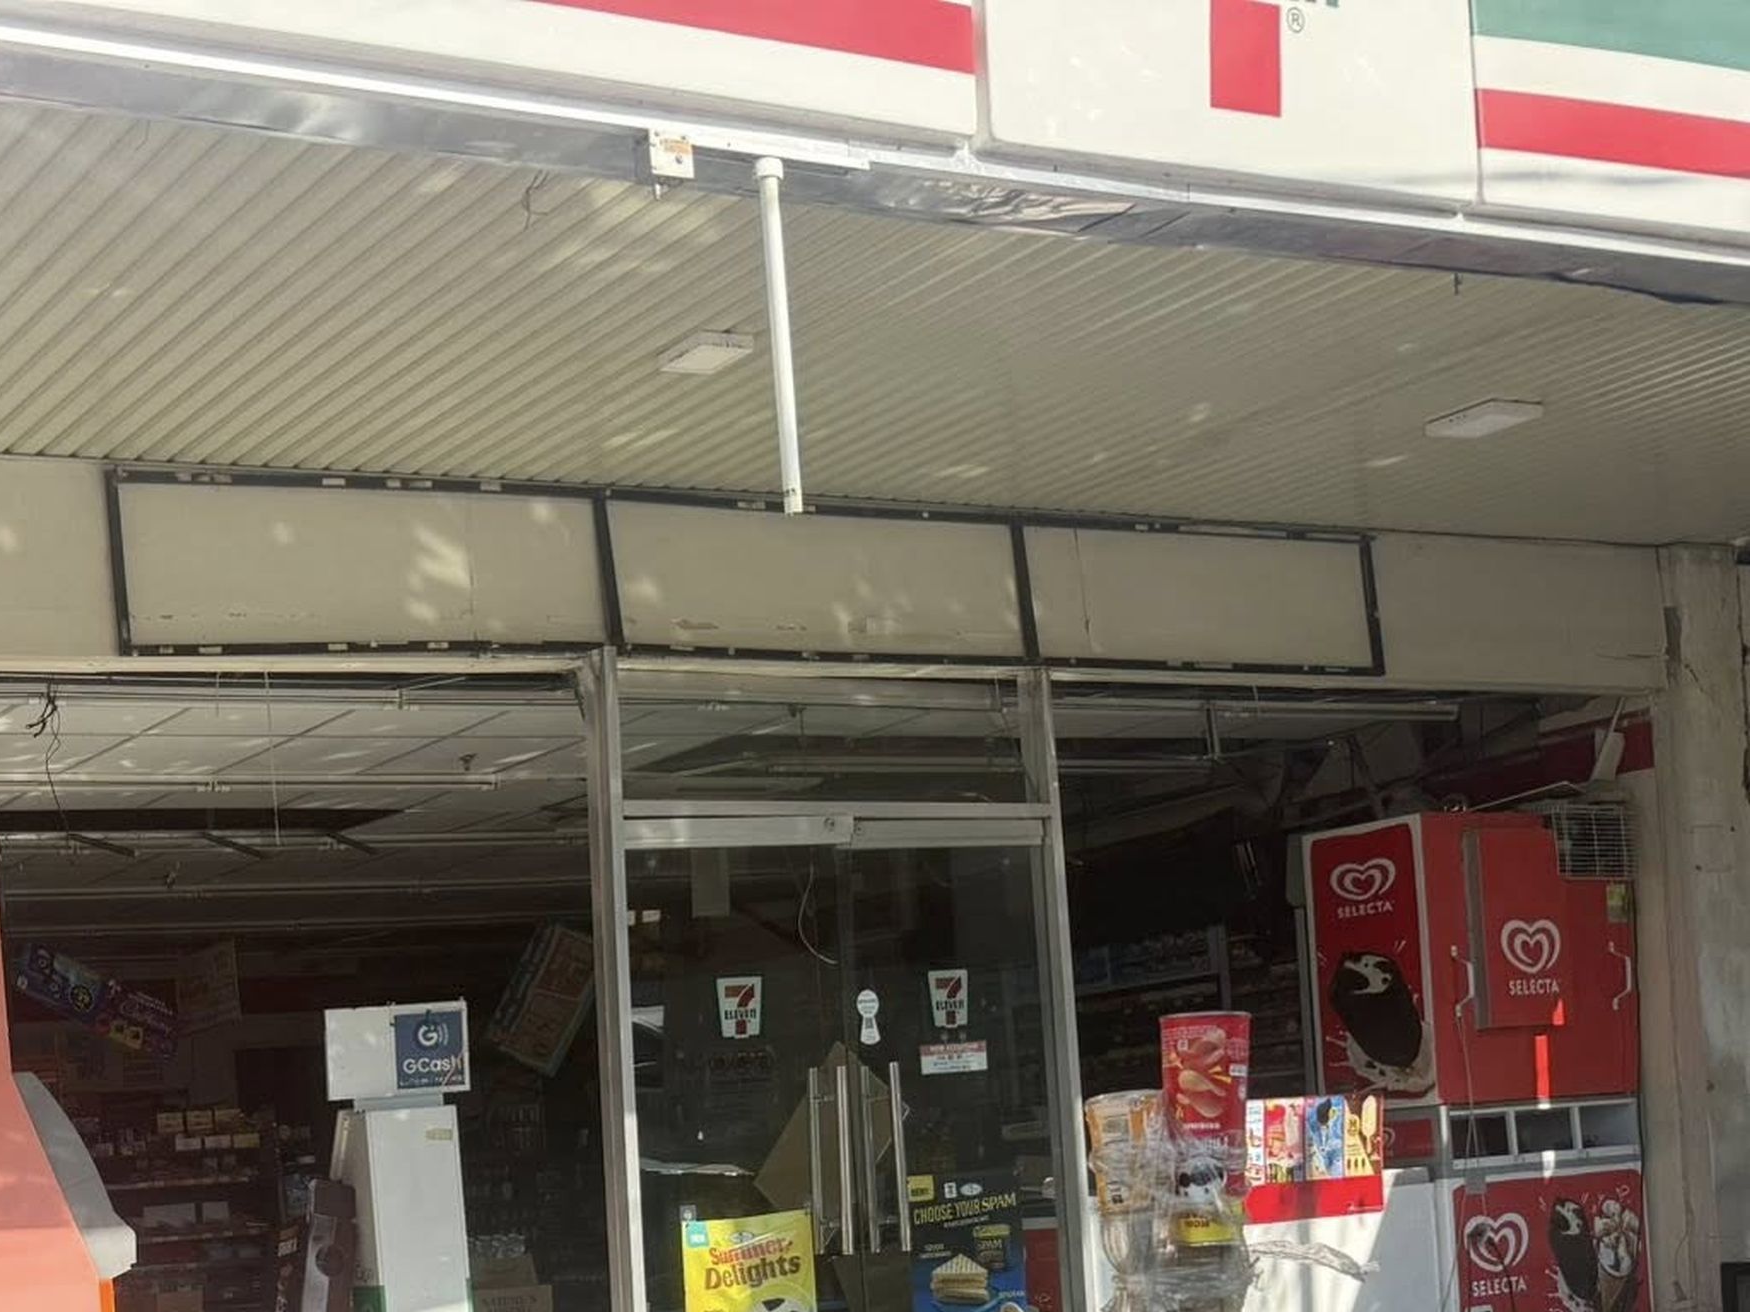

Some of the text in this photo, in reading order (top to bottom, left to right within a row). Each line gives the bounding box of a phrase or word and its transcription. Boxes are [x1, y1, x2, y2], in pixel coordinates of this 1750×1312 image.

[1337, 901, 1393, 918] SELECTA
[1508, 978, 1560, 995] SELECTA
[913, 1203, 954, 1225] CHOOSE
[954, 1198, 981, 1217] YOUR
[981, 1192, 1017, 1213] SPAM
[703, 1255, 802, 1291] Delights
[1471, 1276, 1528, 1297] SELECTA
